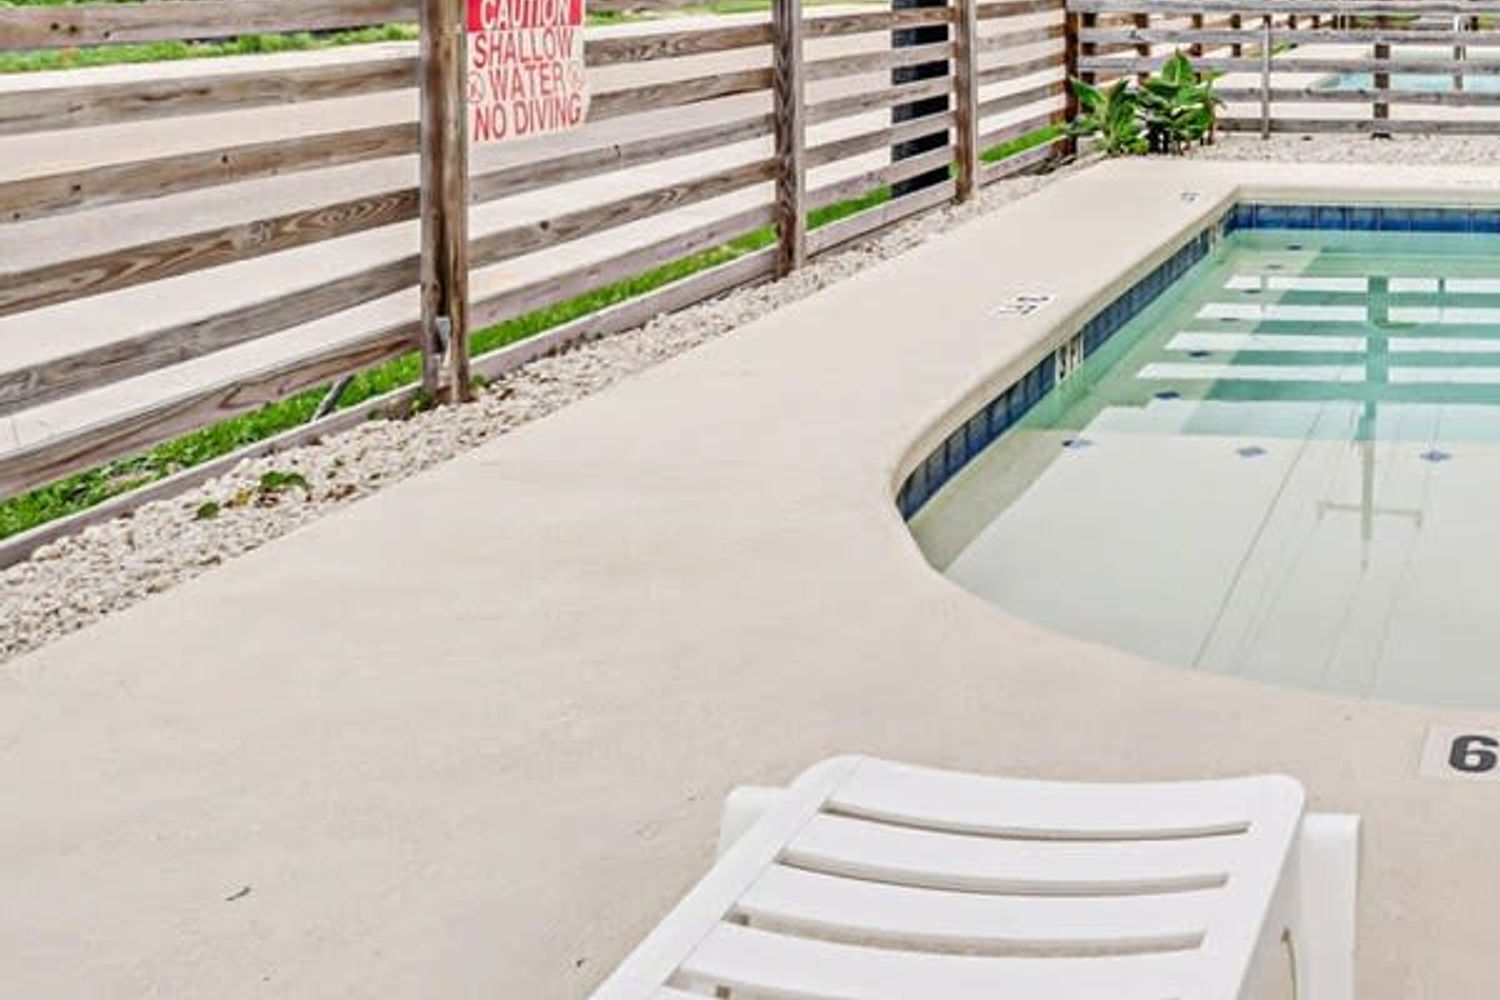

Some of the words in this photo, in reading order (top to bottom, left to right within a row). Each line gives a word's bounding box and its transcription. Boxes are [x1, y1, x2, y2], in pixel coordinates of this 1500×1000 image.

[473, 27, 573, 68] SHALLOW
[489, 62, 566, 100] WATER
[474, 104, 507, 141] NO
[513, 93, 582, 134] DIVING
[1448, 734, 1500, 773] 6
